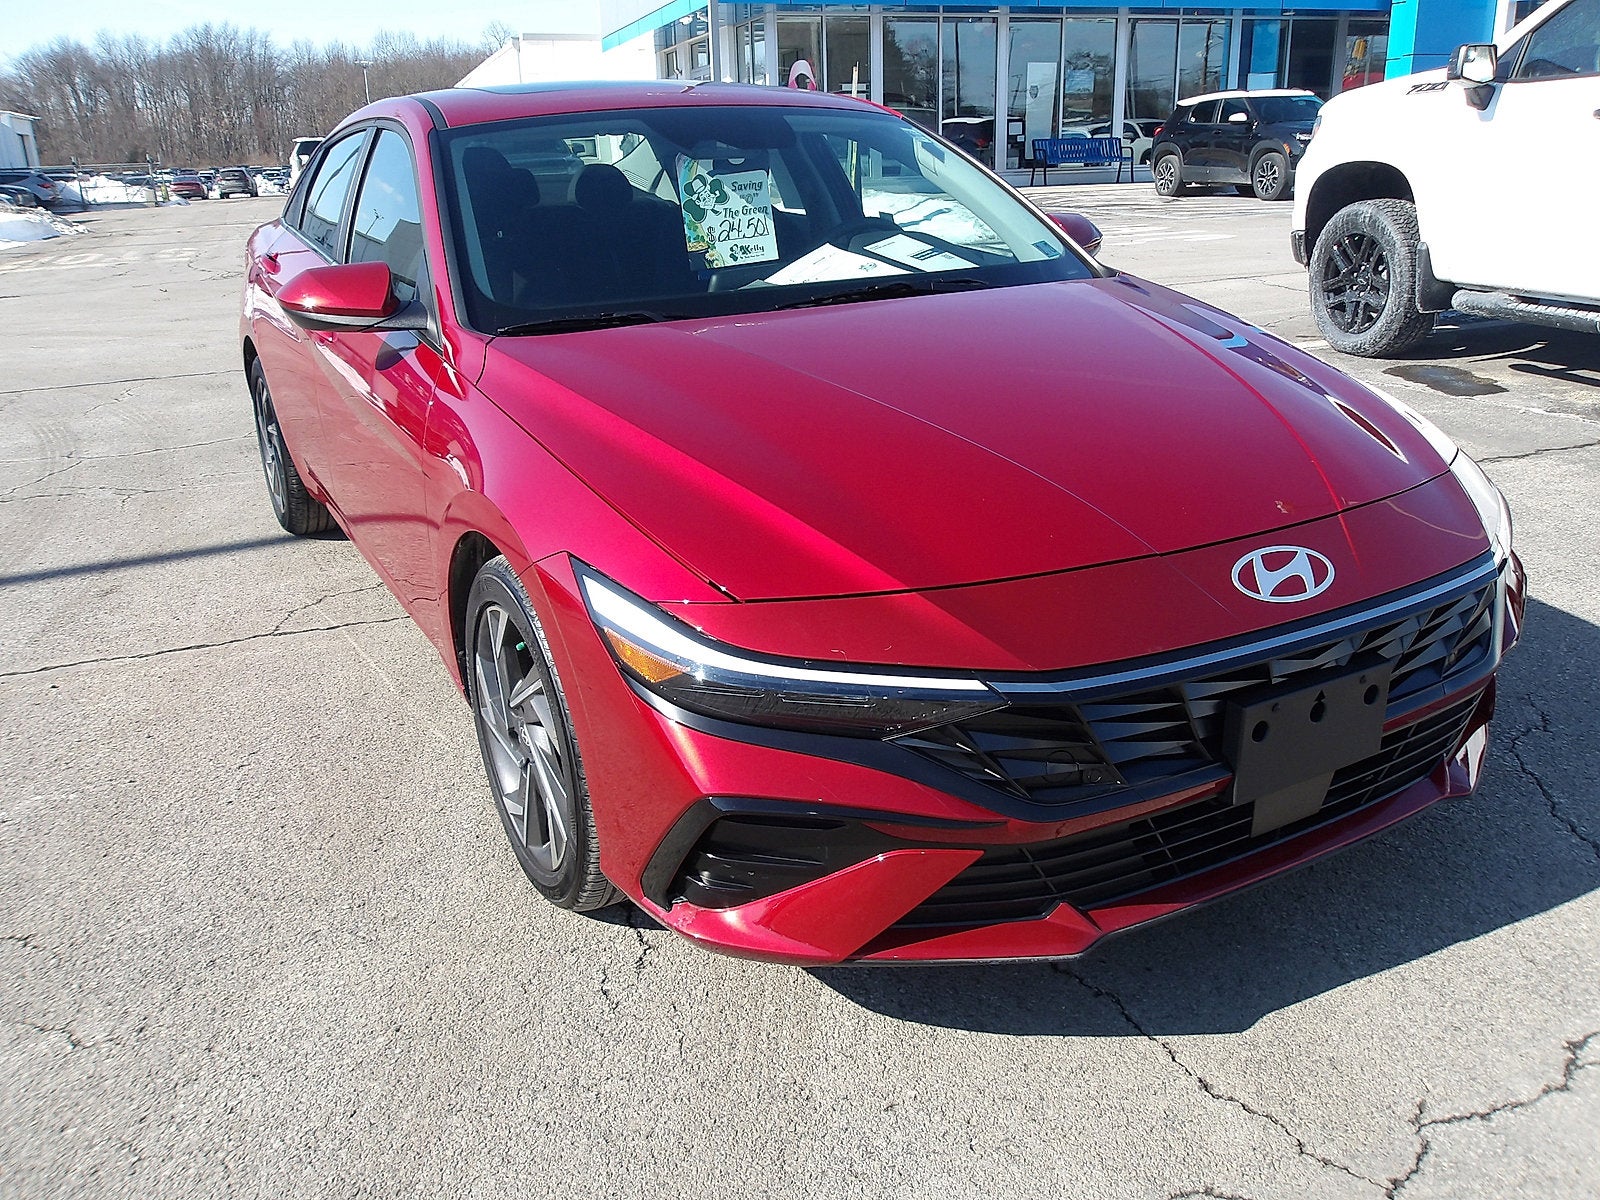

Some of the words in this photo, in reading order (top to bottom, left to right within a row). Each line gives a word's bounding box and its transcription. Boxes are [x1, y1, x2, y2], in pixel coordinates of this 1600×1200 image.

[731, 180, 763, 191] Saving
[723, 207, 739, 218] The
[742, 205, 769, 215] Green
